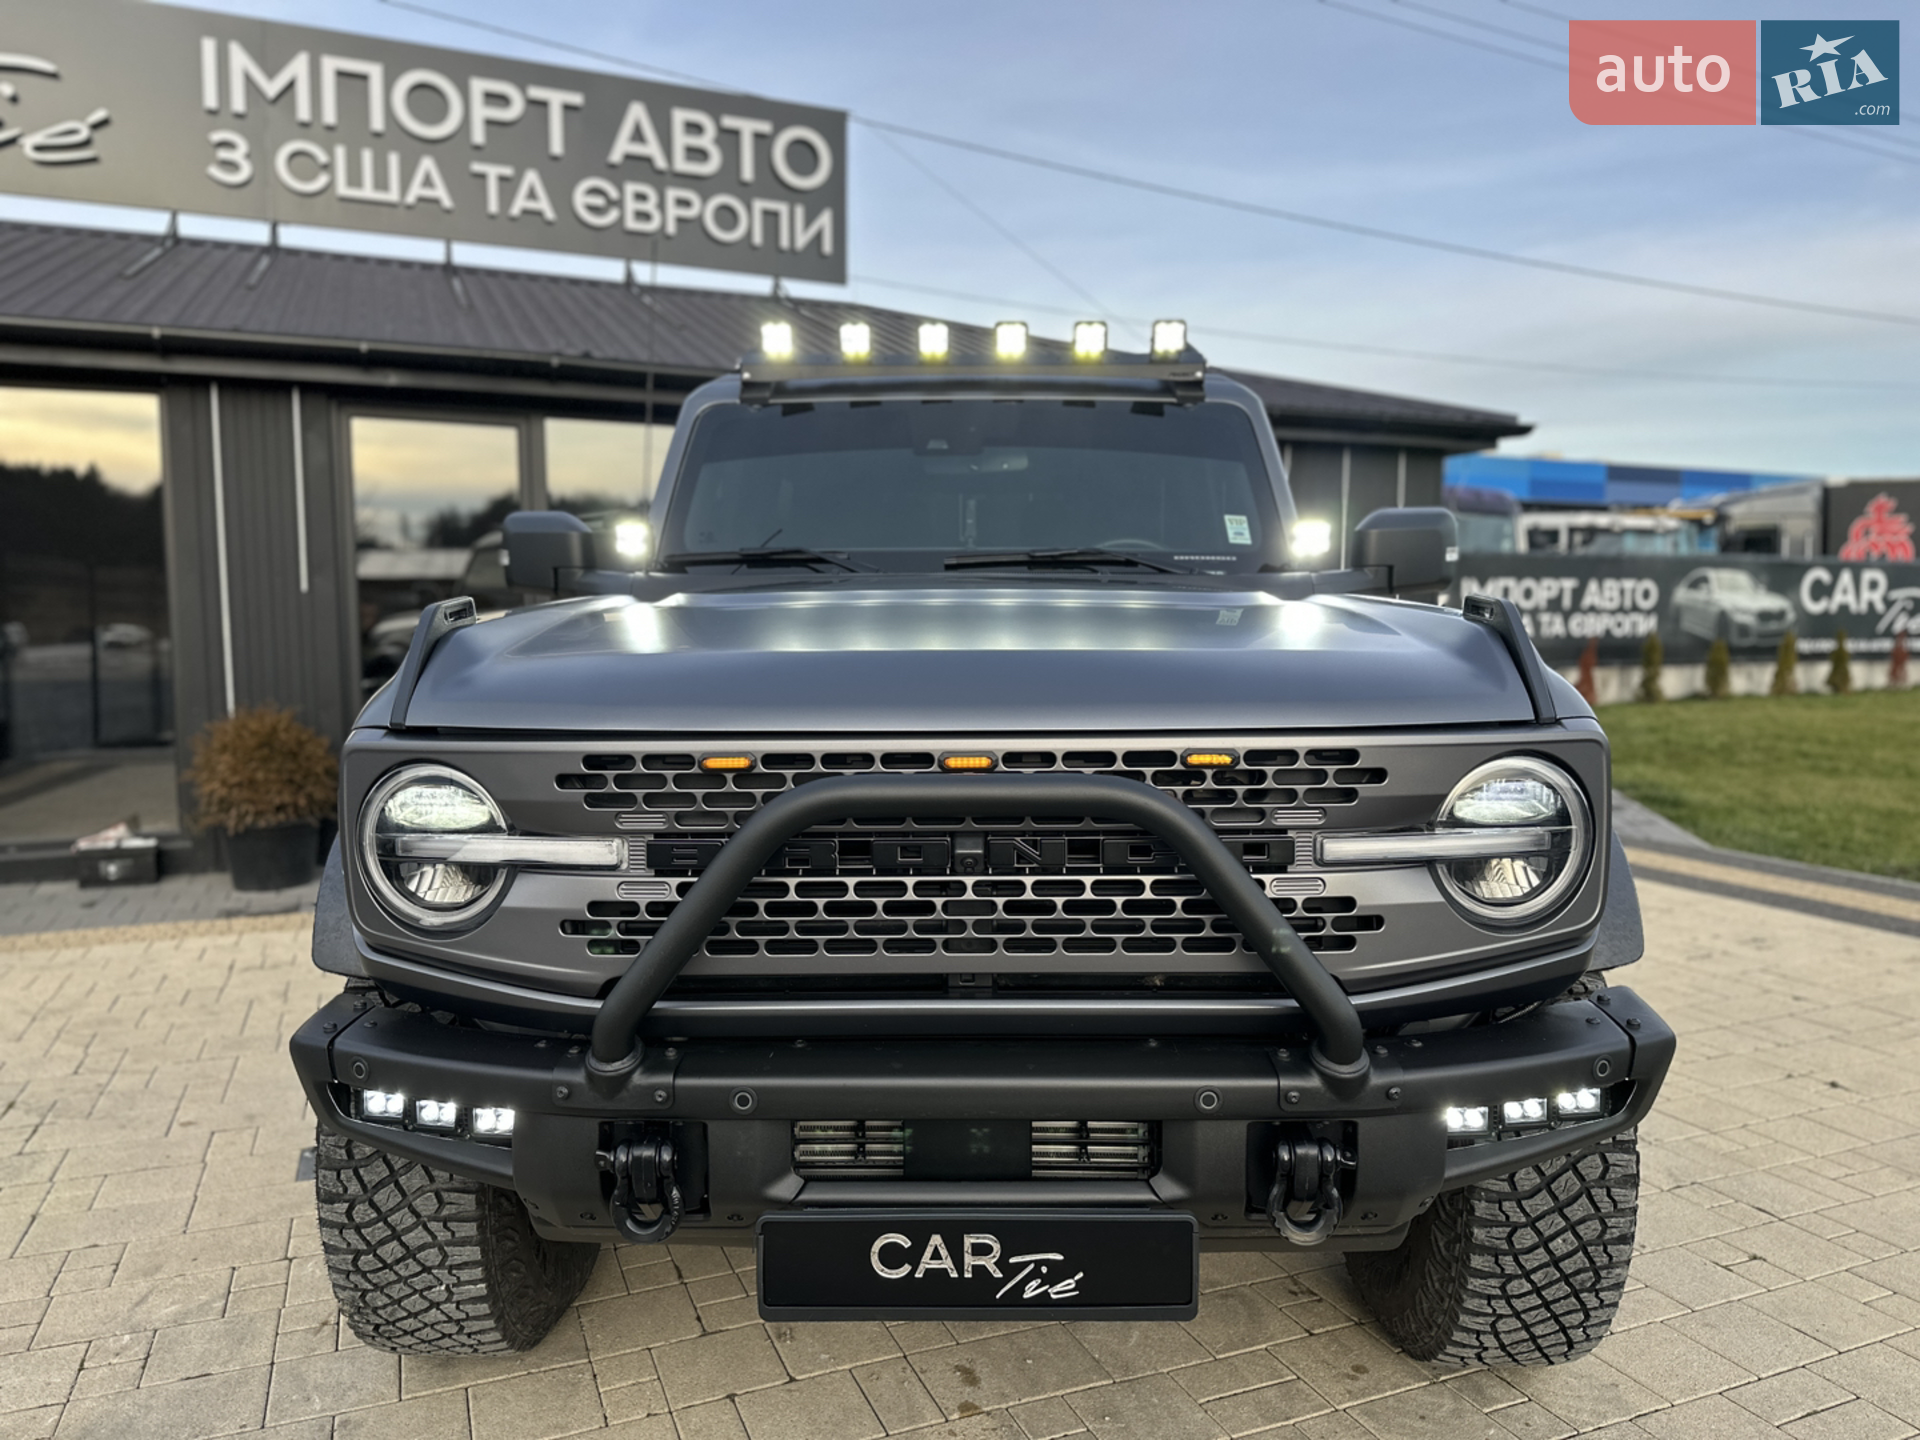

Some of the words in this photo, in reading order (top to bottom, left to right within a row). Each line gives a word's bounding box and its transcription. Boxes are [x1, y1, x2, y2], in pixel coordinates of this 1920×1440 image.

[201, 36, 585, 158] ІМПОРТ
[606, 100, 833, 191] АВТО
[206, 129, 253, 186] З
[274, 139, 454, 211] США
[469, 160, 557, 223] ТА
[571, 176, 833, 256] ЄВРОПИ
[1580, 577, 1660, 611] АВТО
[1800, 566, 1888, 615] CAR
[1538, 612, 1566, 639] ТА
[1567, 612, 1659, 639] ЄВРОПИ
[870, 1233, 1003, 1279] CAR
